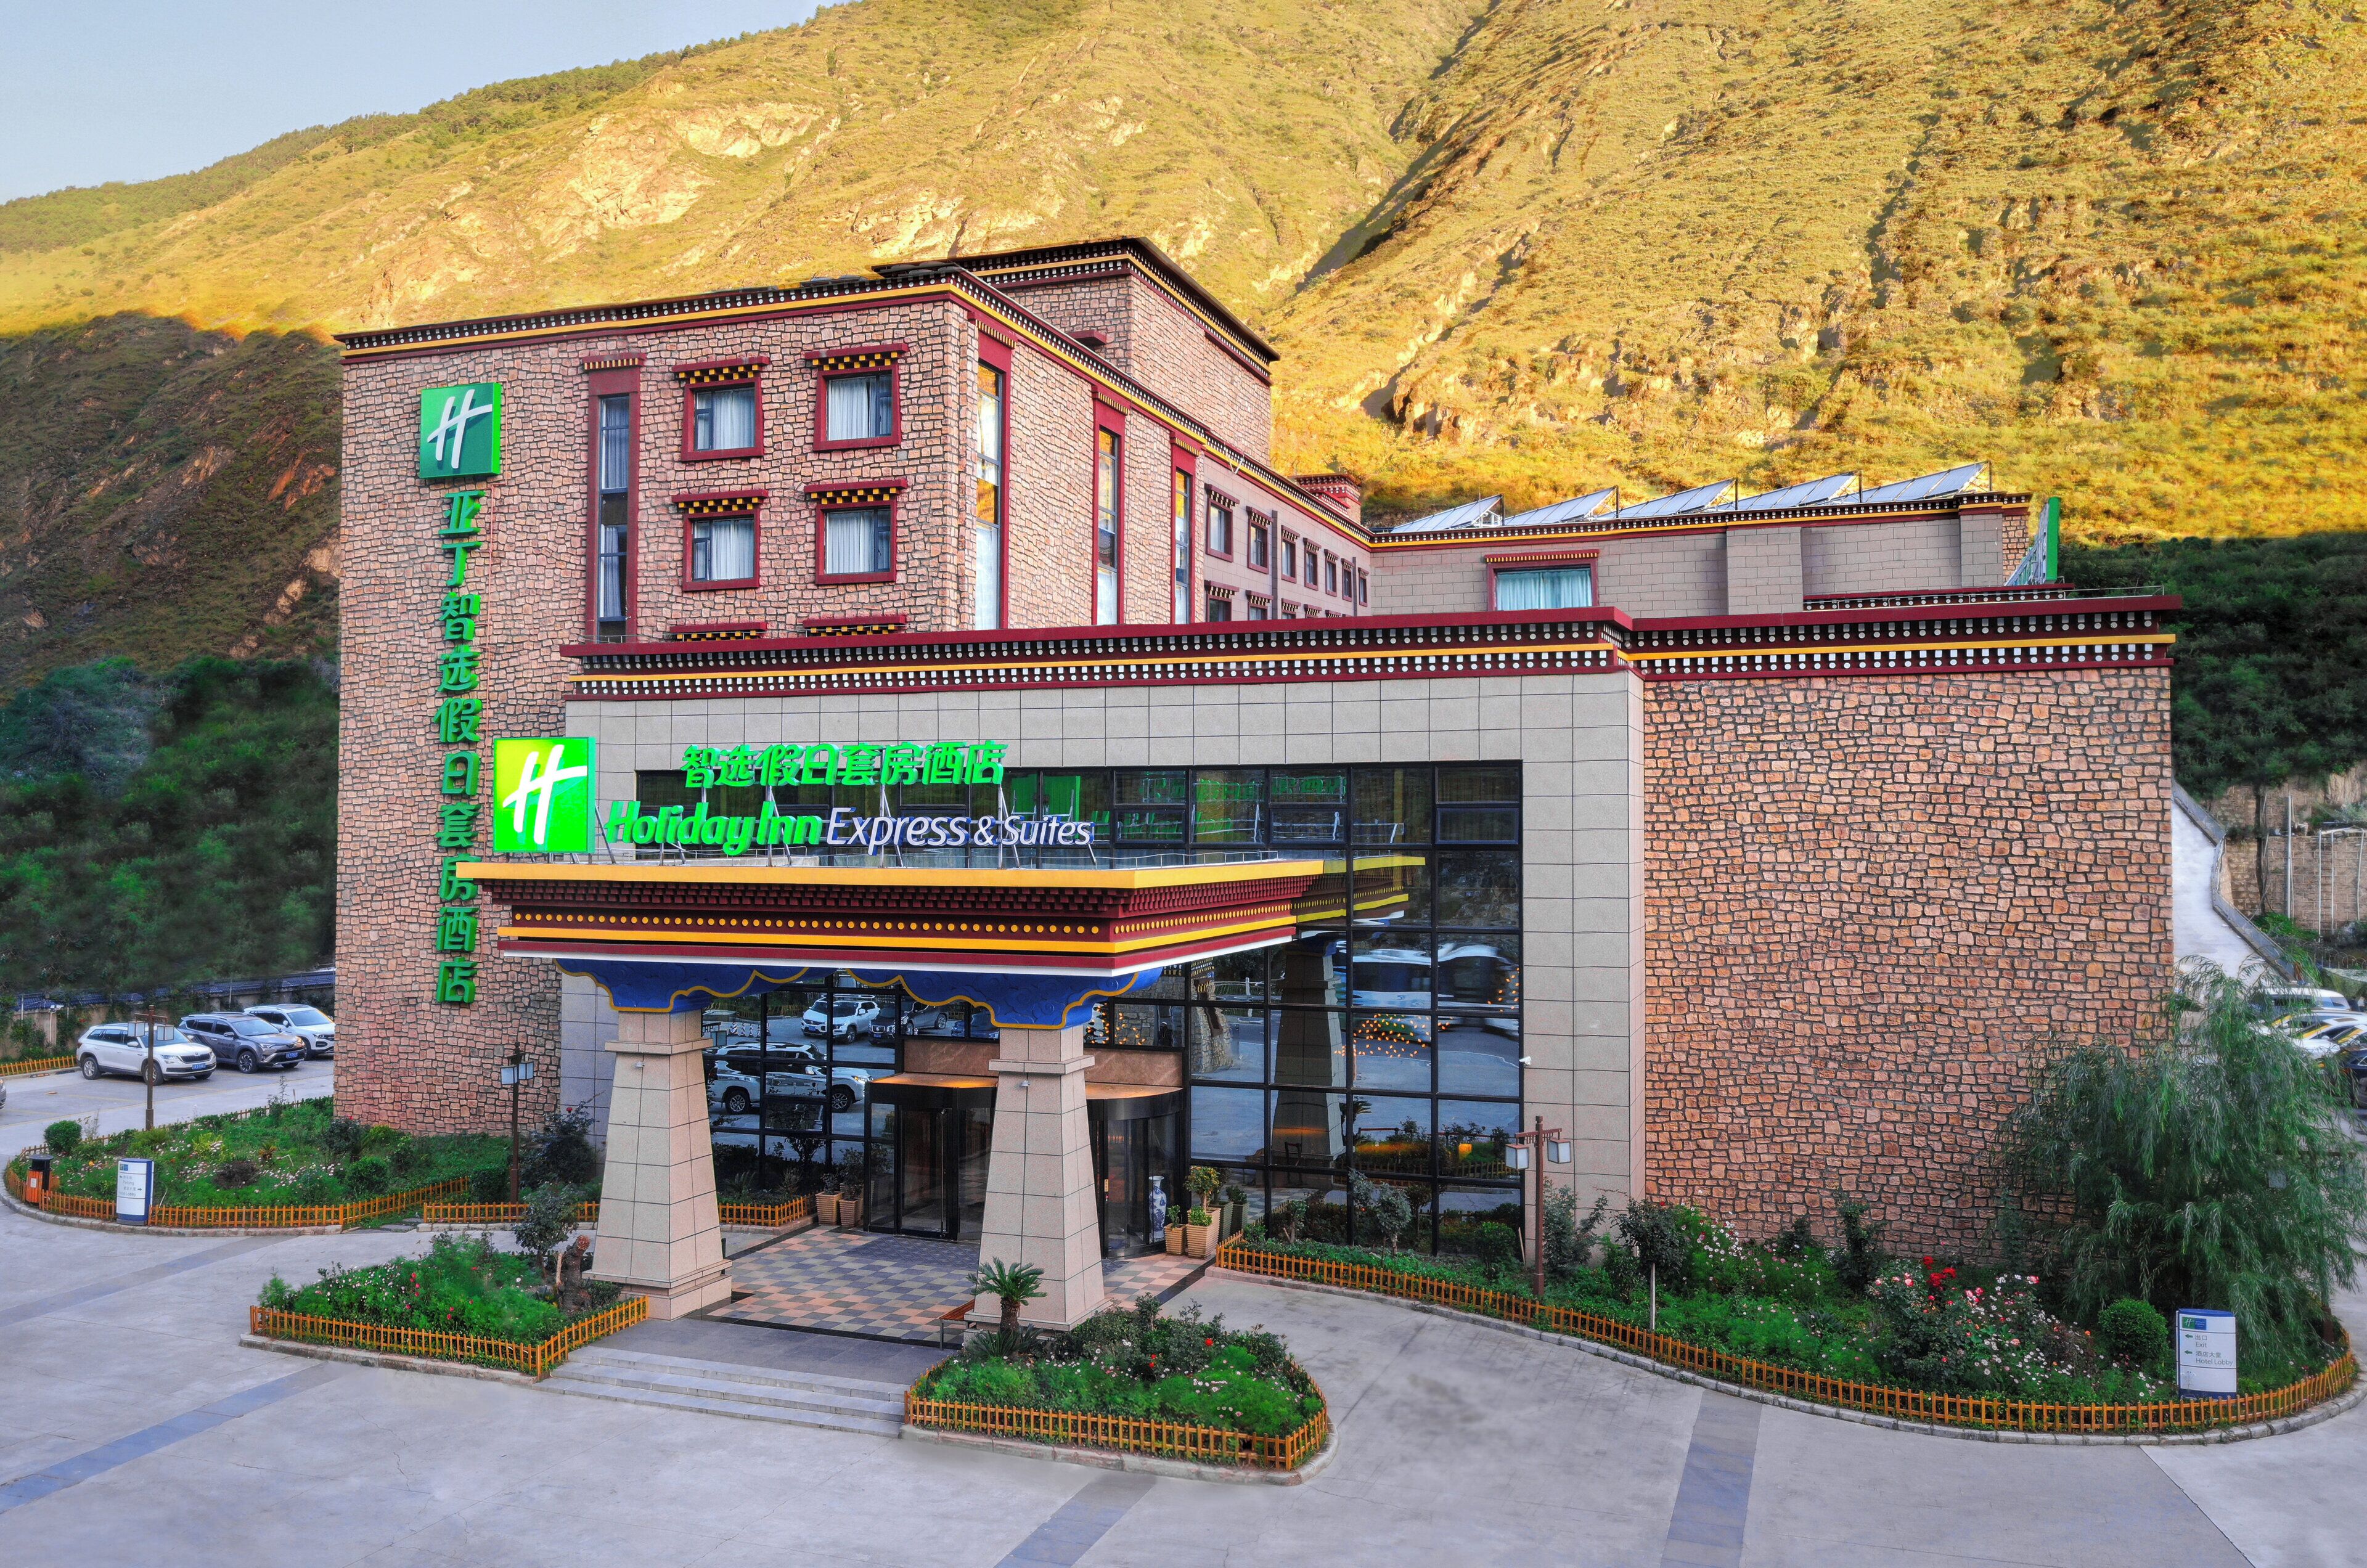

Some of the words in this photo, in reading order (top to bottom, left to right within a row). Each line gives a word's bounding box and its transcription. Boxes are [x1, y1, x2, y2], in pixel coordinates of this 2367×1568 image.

[433, 491, 485, 1003] 亚丁智选假日套房酒店
[680, 740, 1009, 789] 智选假日套房酒店
[604, 801, 756, 856] Holiday
[756, 801, 823, 846] Inn
[826, 807, 971, 856] Express
[973, 815, 999, 847] &
[1001, 815, 1095, 847] Suites
[2214, 1358, 2233, 1366] Lobby
